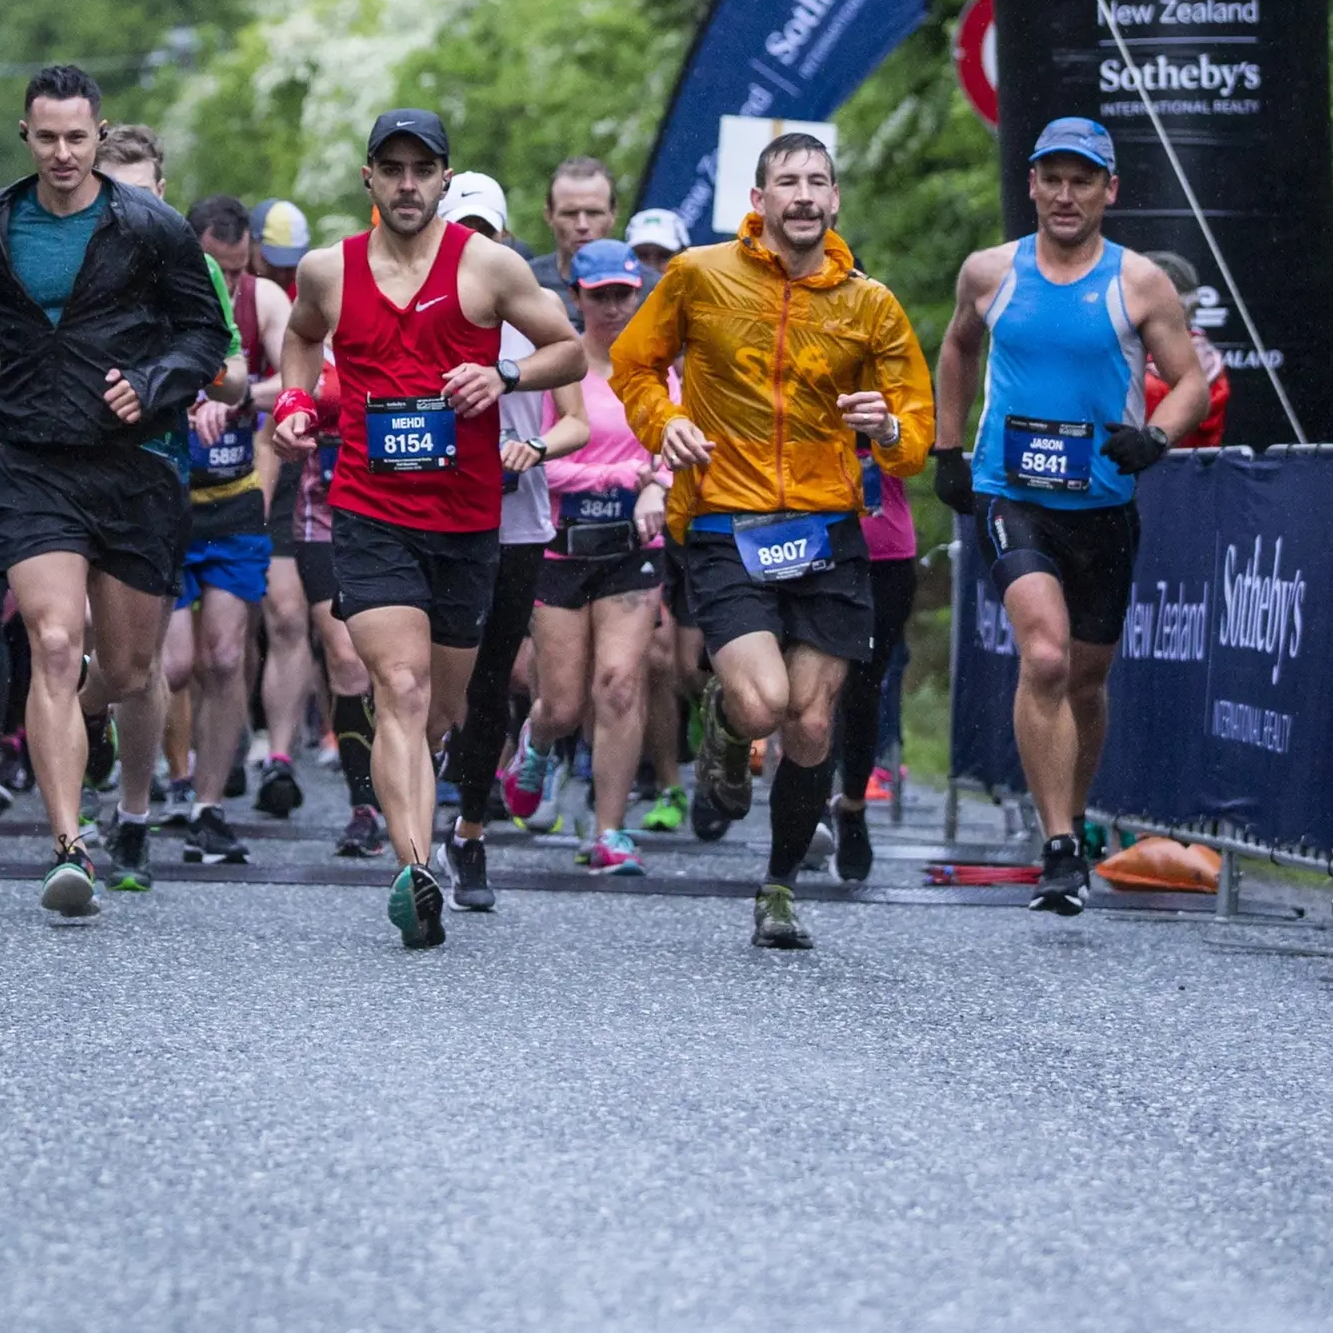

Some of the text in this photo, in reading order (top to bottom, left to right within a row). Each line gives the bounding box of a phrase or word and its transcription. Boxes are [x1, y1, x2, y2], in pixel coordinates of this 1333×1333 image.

[1099, 53, 1262, 97] Sotheby's
[1100, 100, 1212, 116] INTERNTIONAL
[391, 416, 425, 429] MEHDI
[384, 432, 434, 454] 8154
[1029, 437, 1064, 451] JASON
[1021, 451, 1068, 474] 5841
[757, 538, 807, 566] 8907
[1154, 580, 1210, 661] Zealand
[1219, 534, 1306, 685] Sotheby's
